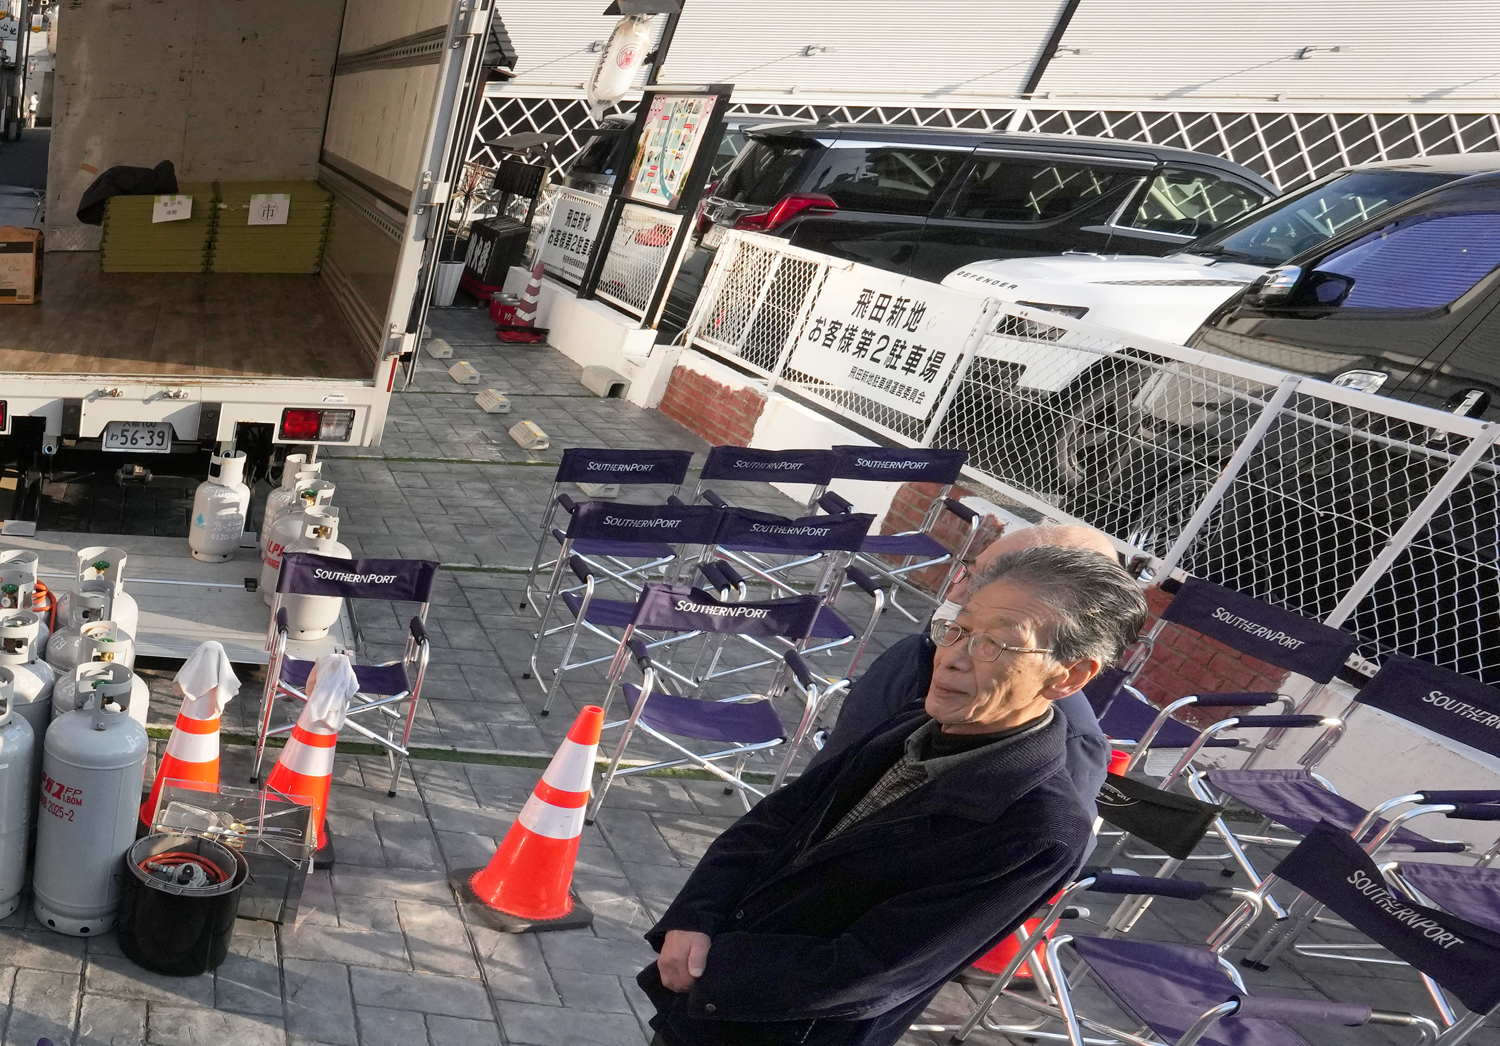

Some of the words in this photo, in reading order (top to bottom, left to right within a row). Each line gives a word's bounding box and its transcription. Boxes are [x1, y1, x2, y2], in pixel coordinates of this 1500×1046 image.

[565, 209, 591, 232] 飛田新地
[956, 270, 1018, 290] DEFENDER
[851, 288, 927, 333] 飛田新地
[807, 315, 947, 384] お客様第2駐車場
[120, 429, 166, 446] 56-39
[587, 461, 654, 473] SOUTHERNPORT
[734, 459, 803, 471] SOUTHERNPORT
[855, 458, 929, 470] SOUTHERNPORT
[603, 515, 681, 529] SOUTHERNPORT
[750, 523, 830, 537] SOUTHERNPORT
[313, 568, 397, 585] SOUTHERNPORT
[675, 600, 771, 619] SOUTHERNPORT
[1211, 607, 1304, 651] SOUTHERNPORT
[64, 787, 83, 797] FP
[1347, 869, 1464, 950] SOUTHERNPORT
